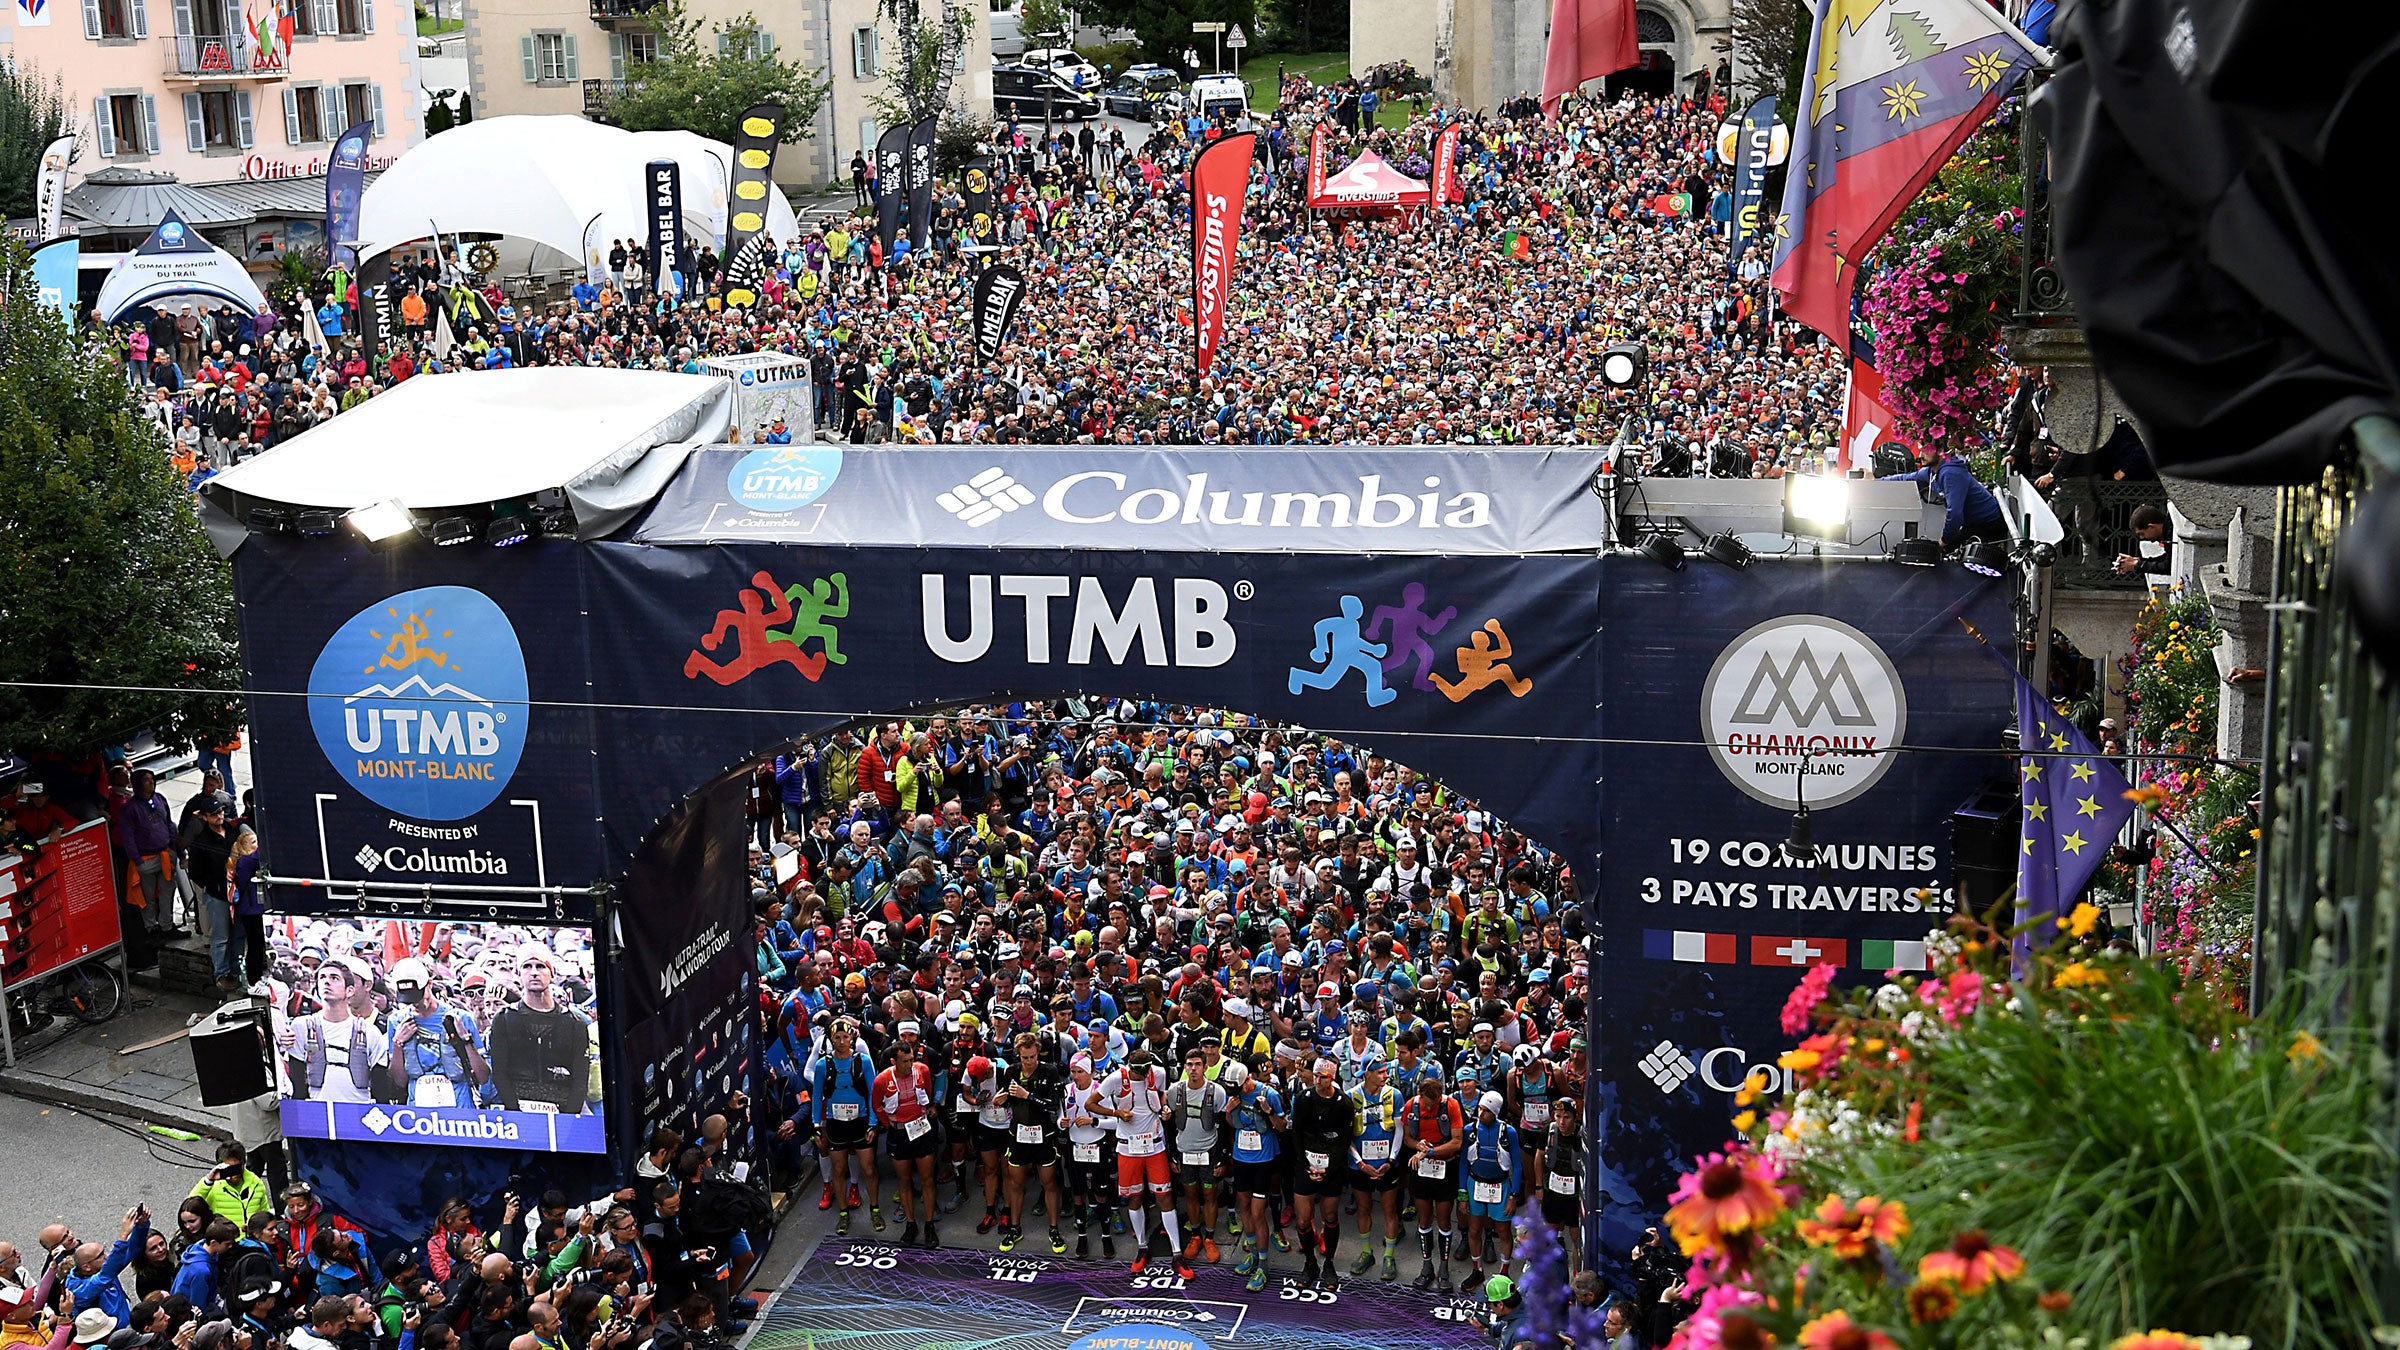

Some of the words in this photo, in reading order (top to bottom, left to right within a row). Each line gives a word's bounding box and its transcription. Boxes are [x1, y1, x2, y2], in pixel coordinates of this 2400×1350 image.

[247, 154, 303, 180] Office
[656, 169, 672, 207] BAR
[174, 260, 218, 269] MONDIAL
[978, 274, 1020, 359] CAMELBAK
[756, 363, 807, 384] UTMB
[1042, 470, 1493, 531] Columbia
[739, 518, 801, 527] Columbia
[1728, 733, 1878, 759] CHAMONIX
[356, 759, 496, 782] MONT-BLANC
[388, 818, 462, 840] PRESENTED
[463, 824, 479, 839] BY
[383, 847, 509, 876] Columbia
[1670, 838, 1710, 865] 19
[1640, 877, 1662, 903] 3
[1672, 879, 1759, 909] PAYS
[1767, 880, 1955, 914] TRAVERSÉS
[685, 946, 711, 977] WORLD
[710, 930, 731, 955] TOUR
[391, 1109, 520, 1141] Columbia
[834, 1252, 898, 1270] OCC
[1132, 1276, 1187, 1290] TDS
[1280, 1287, 1338, 1305] CCC
